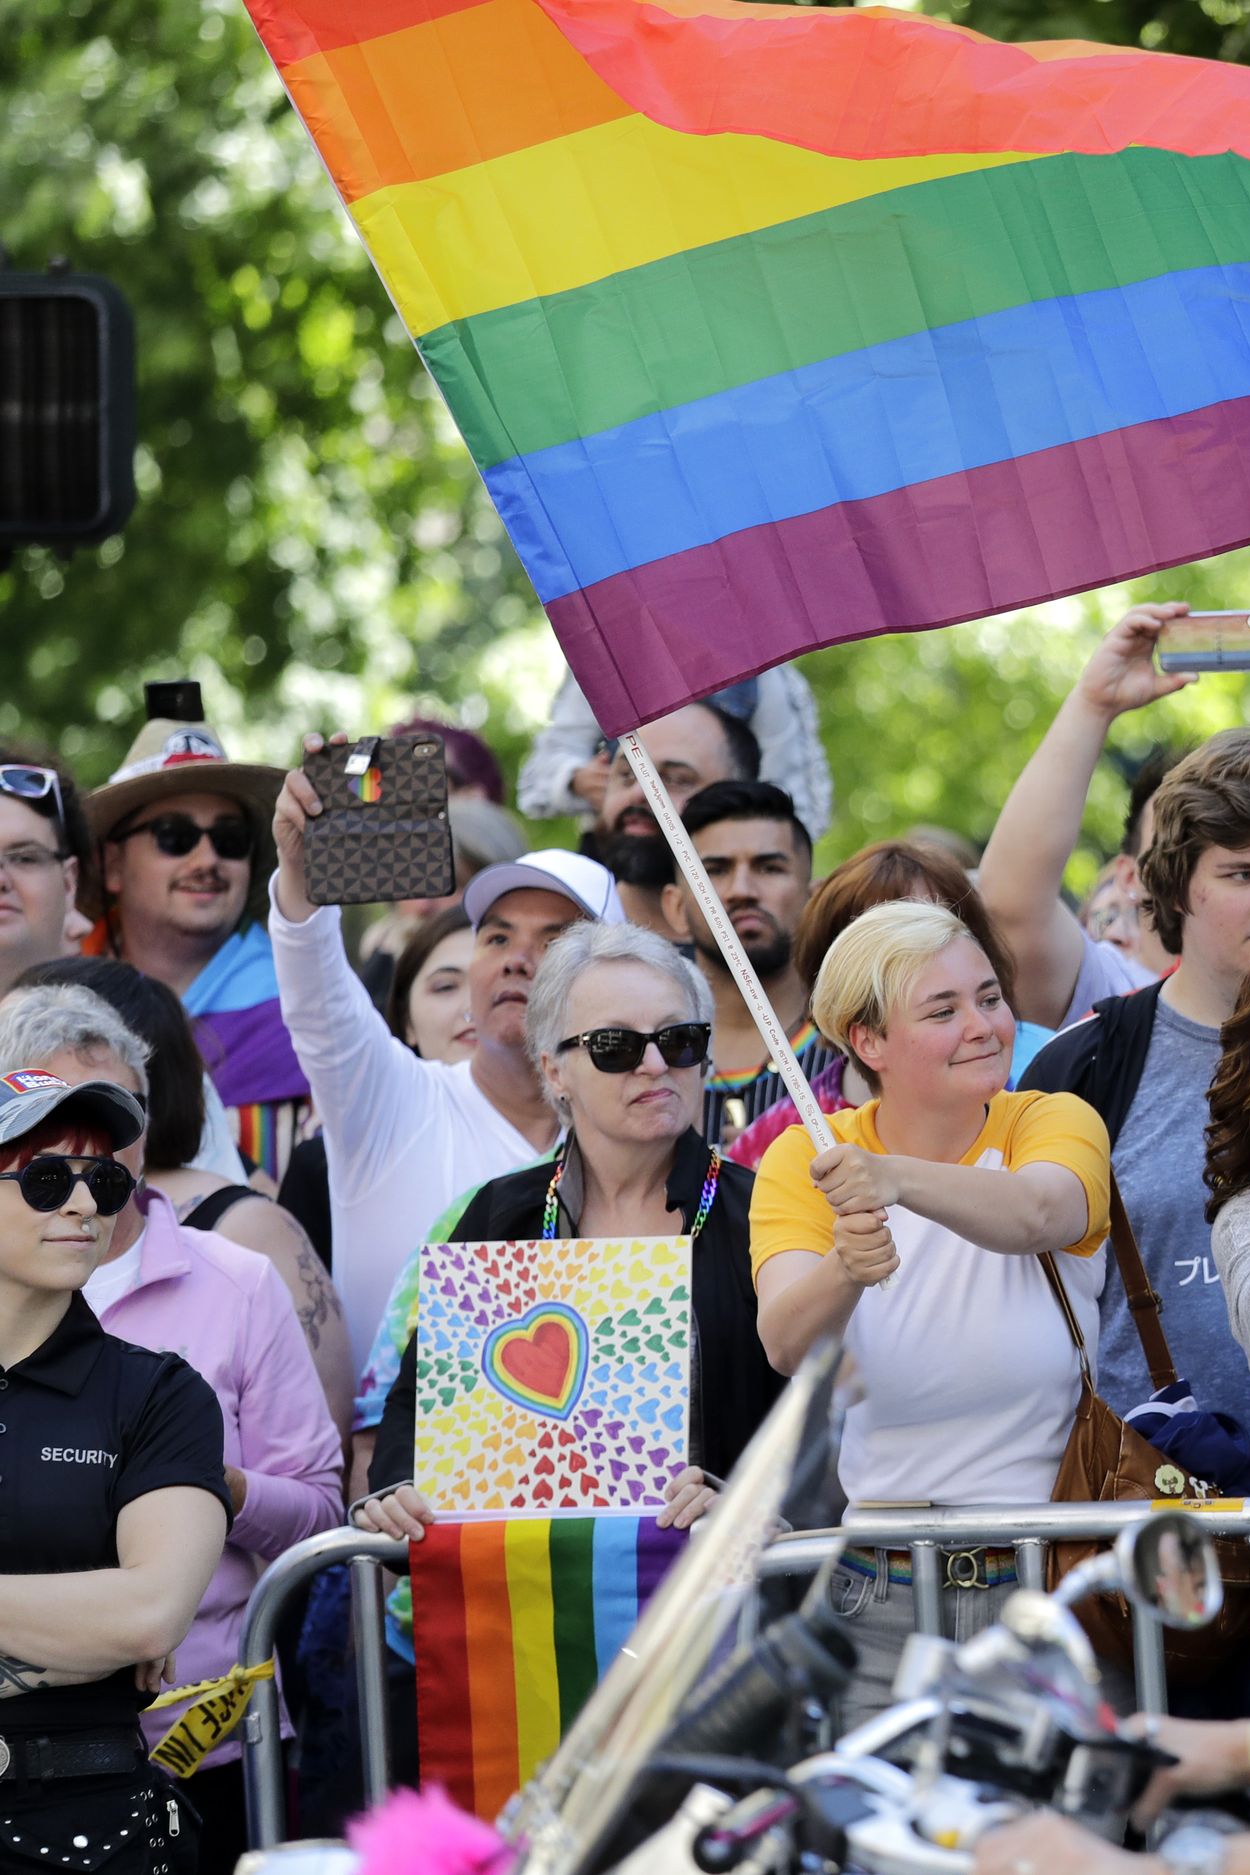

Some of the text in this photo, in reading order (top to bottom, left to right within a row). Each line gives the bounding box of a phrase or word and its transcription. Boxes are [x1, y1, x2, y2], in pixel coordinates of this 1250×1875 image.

[626, 735, 643, 759] PE
[681, 850, 691, 863] PVC
[689, 865, 700, 880] 1120
[697, 882, 707, 894] SCH
[704, 897, 712, 905] 40
[709, 906, 717, 915] PR
[720, 930, 730, 943] PSI
[769, 1029, 779, 1046] Code
[1174, 1256, 1219, 1286] プレ
[40, 1447, 118, 1468] SECURITY
